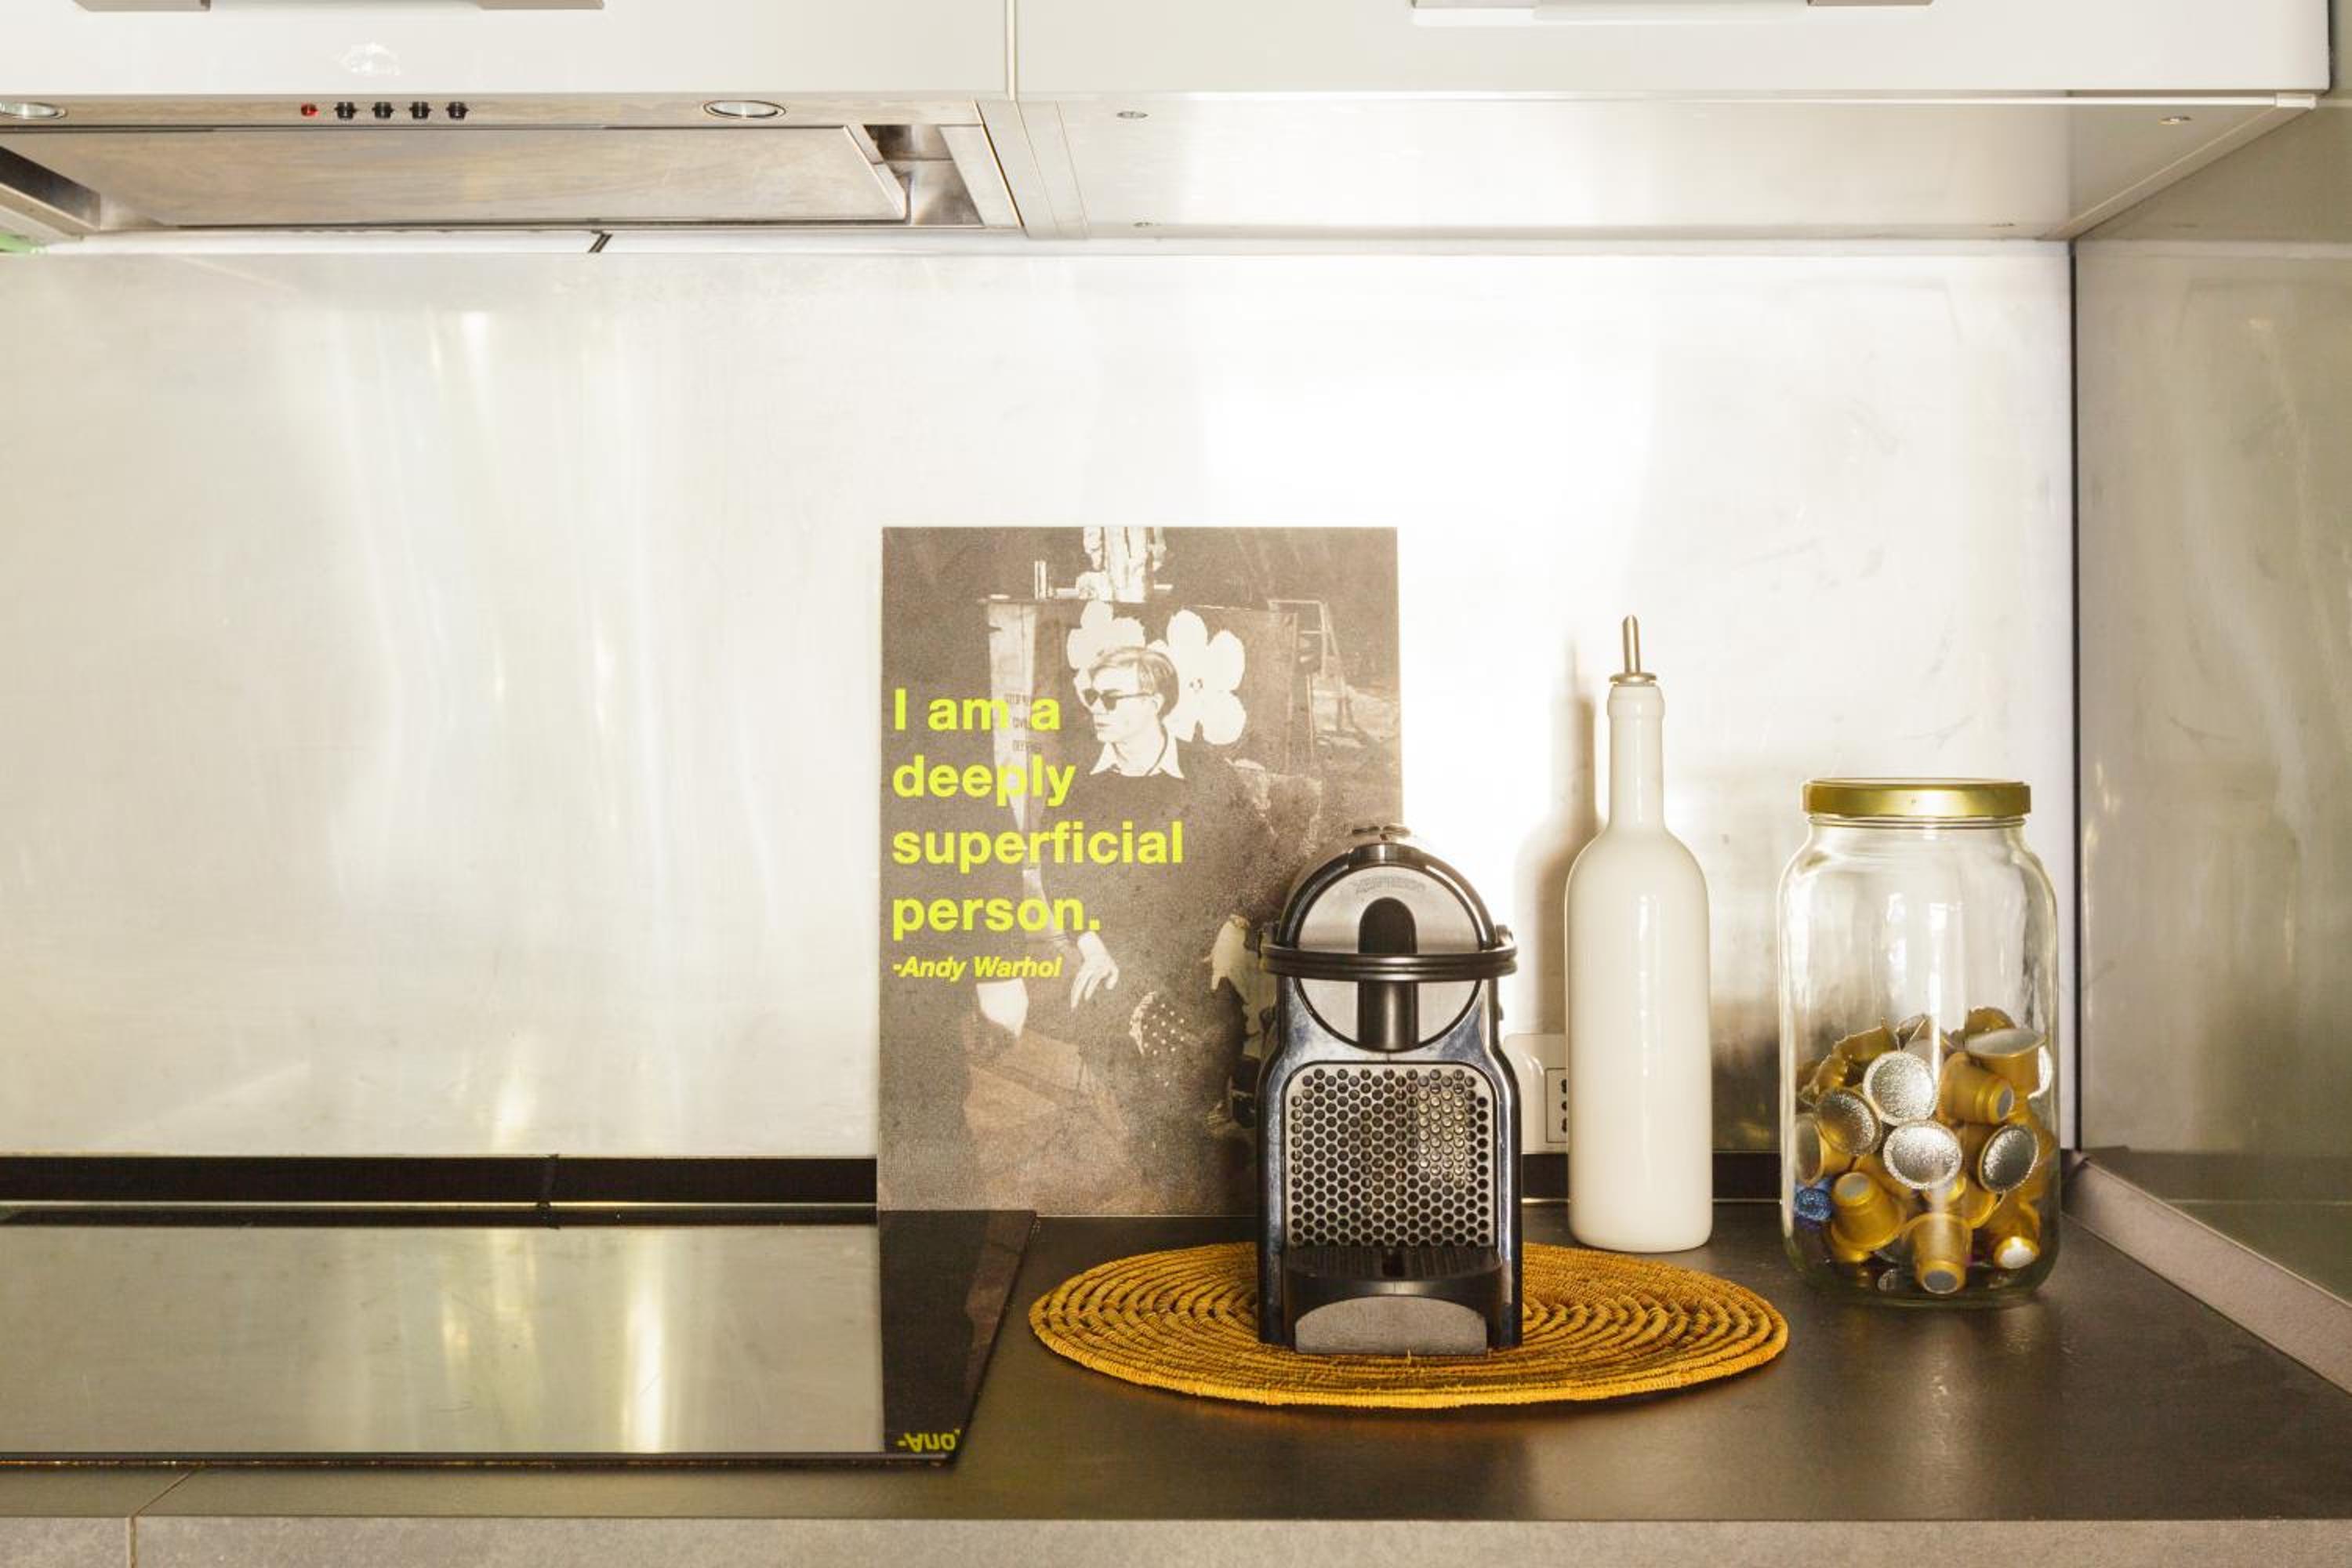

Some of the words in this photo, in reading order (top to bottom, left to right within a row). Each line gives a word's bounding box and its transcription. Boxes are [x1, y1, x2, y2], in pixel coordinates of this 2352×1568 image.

[895, 688, 906, 730] I
[927, 698, 1009, 730] am
[1030, 698, 1061, 730] a
[892, 754, 1076, 807] deeply
[892, 820, 1183, 873] superficial
[892, 897, 1101, 941] person.
[892, 956, 966, 982] -Andy
[974, 956, 1062, 978] Warhol
